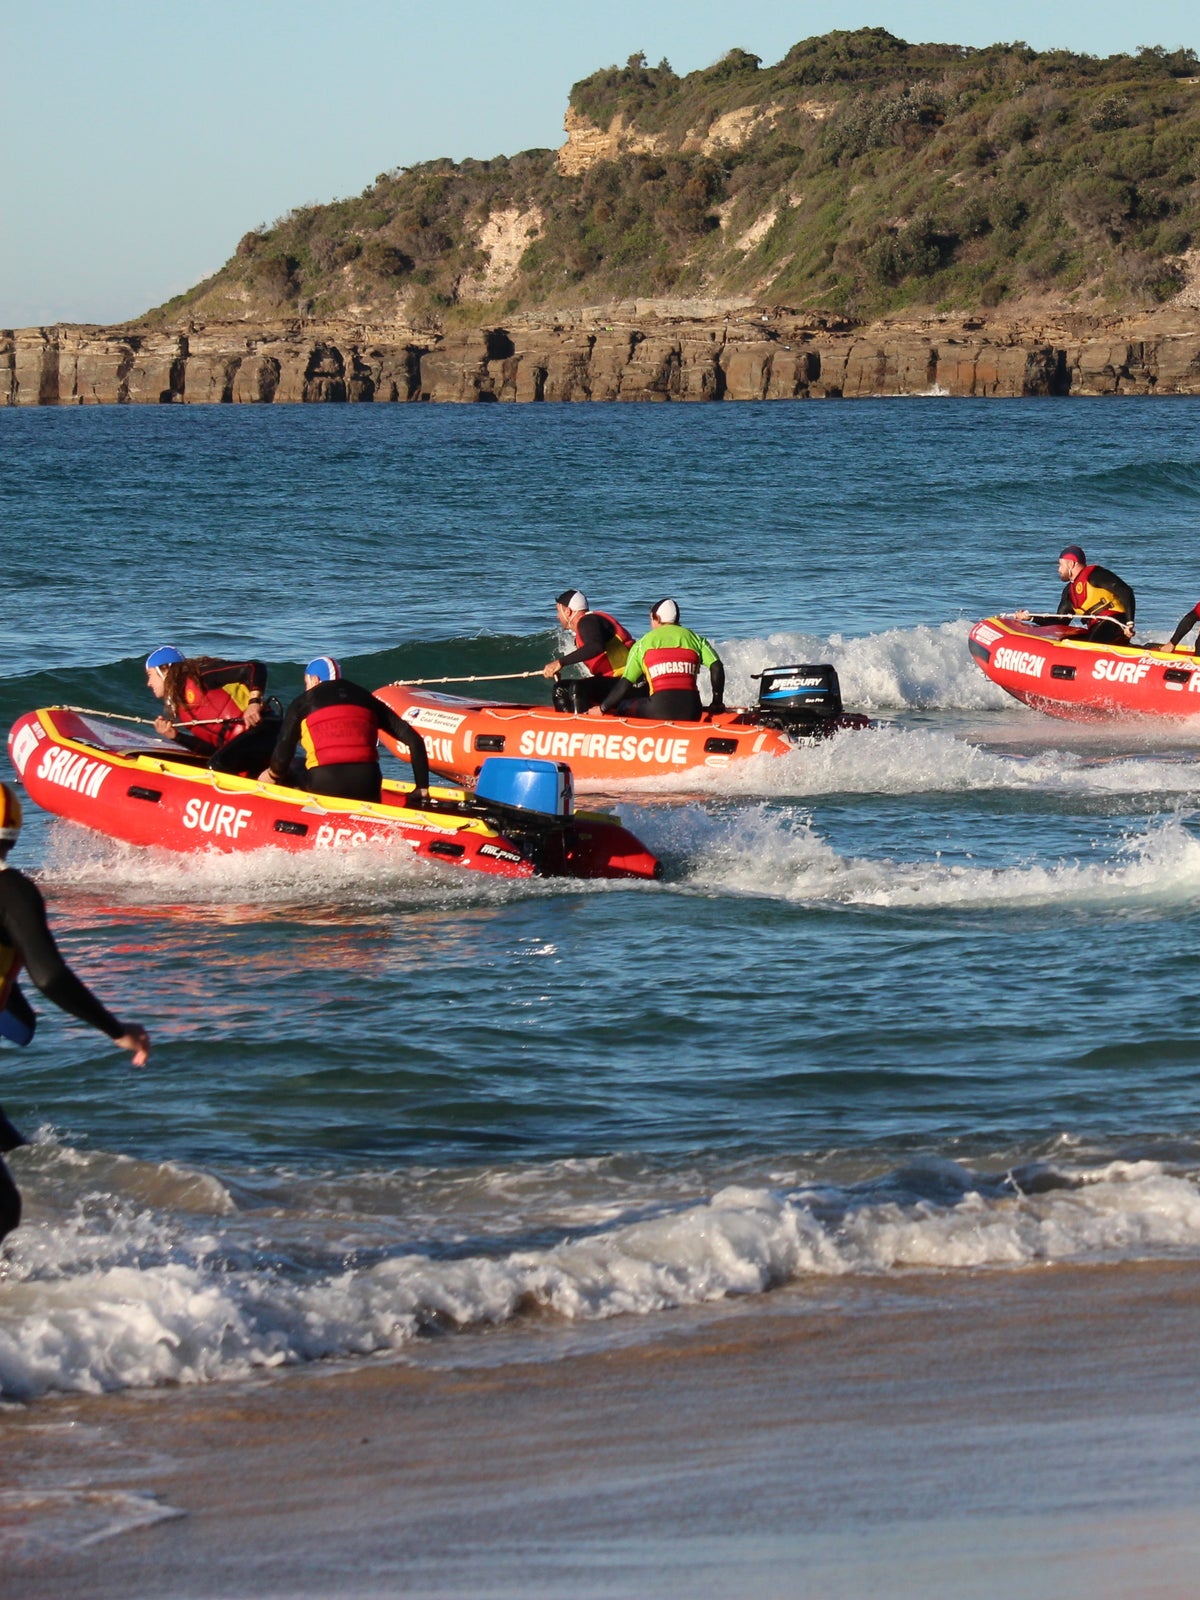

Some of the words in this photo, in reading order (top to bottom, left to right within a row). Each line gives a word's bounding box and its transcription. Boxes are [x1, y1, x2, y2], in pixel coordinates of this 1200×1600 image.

[648, 661, 696, 679] NEWCASTLE
[994, 647, 1046, 678] SRHG2N
[1092, 659, 1150, 685] SURF
[769, 678, 823, 690] MERCURY
[519, 730, 584, 757] SURF
[589, 734, 690, 764] RESCUE
[37, 746, 112, 798] SRIA1N
[183, 798, 252, 838] SURF
